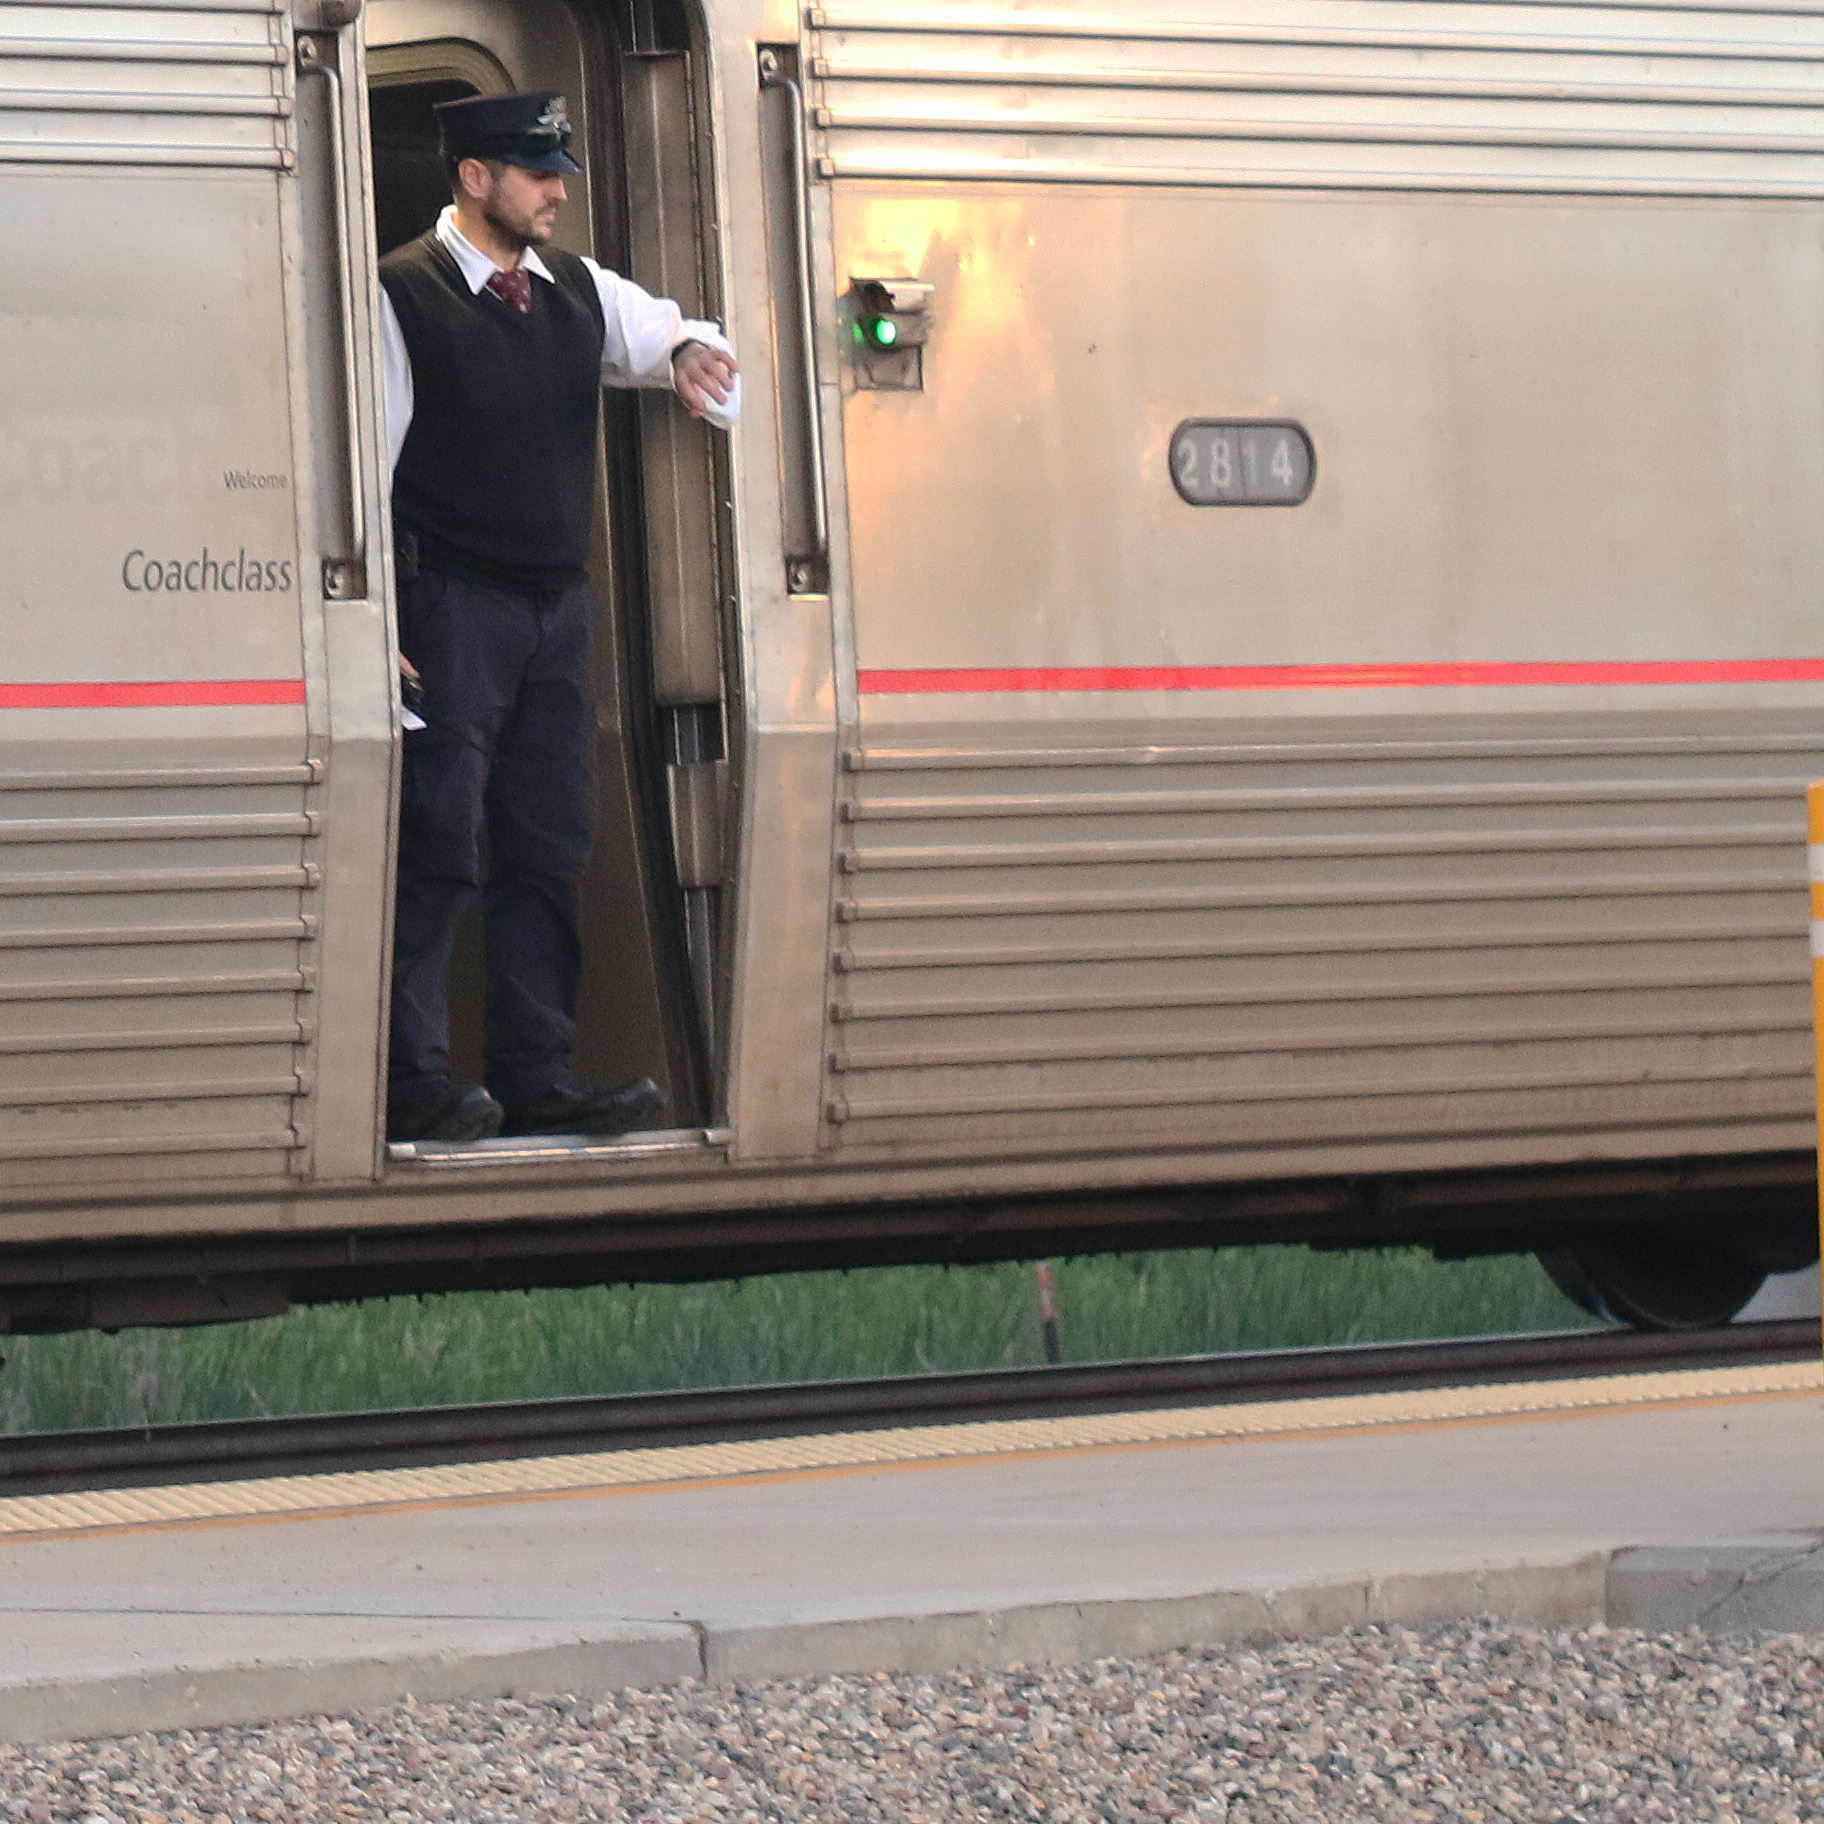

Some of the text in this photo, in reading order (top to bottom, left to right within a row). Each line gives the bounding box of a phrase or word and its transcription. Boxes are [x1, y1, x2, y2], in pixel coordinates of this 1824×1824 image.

[223, 470, 290, 490] Welcome
[1177, 438, 1293, 488] 2814
[120, 545, 292, 593] Coachclass
